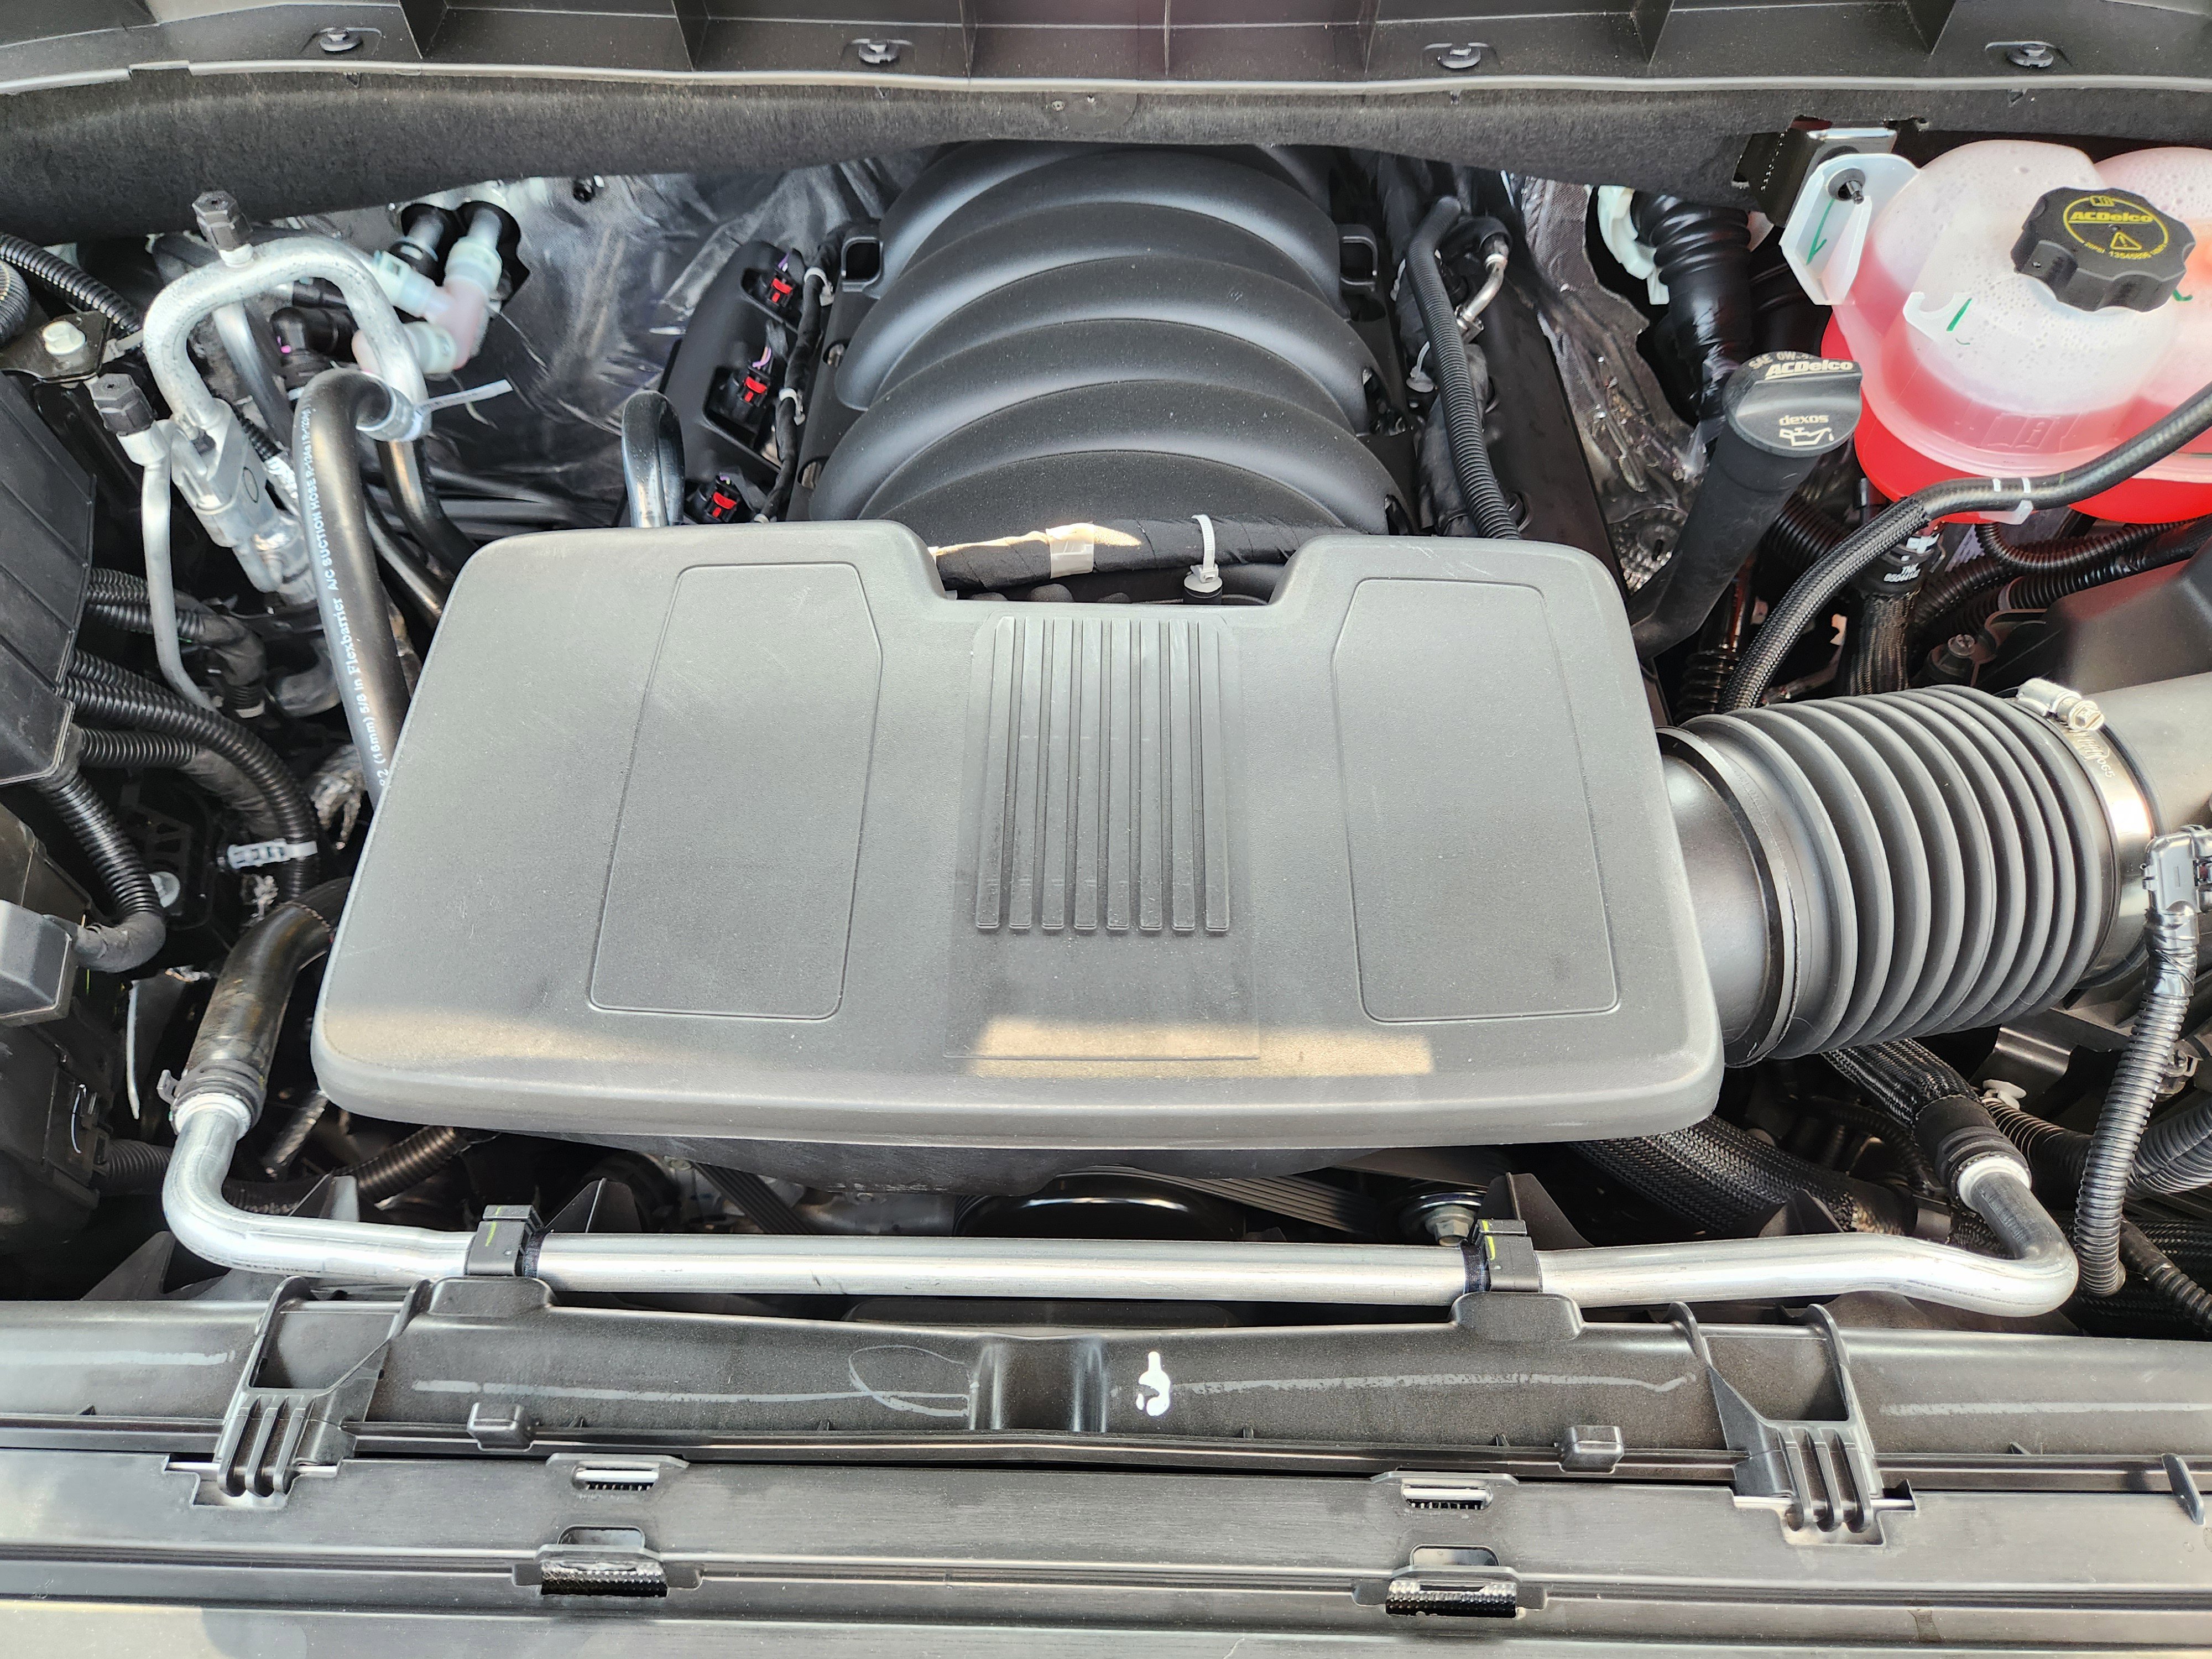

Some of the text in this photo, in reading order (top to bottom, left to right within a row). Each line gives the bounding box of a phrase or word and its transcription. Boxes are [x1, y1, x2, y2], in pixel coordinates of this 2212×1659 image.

[2069, 211, 2153, 222] ACDelco
[1748, 354, 1773, 370] SAE
[1765, 359, 1853, 377] ACDelco
[1778, 415, 1829, 426] dexos
[306, 478, 321, 510] HOSE
[312, 511, 333, 567] SUCTION
[324, 568, 340, 591] A/C
[333, 598, 362, 676] Flexbarrier
